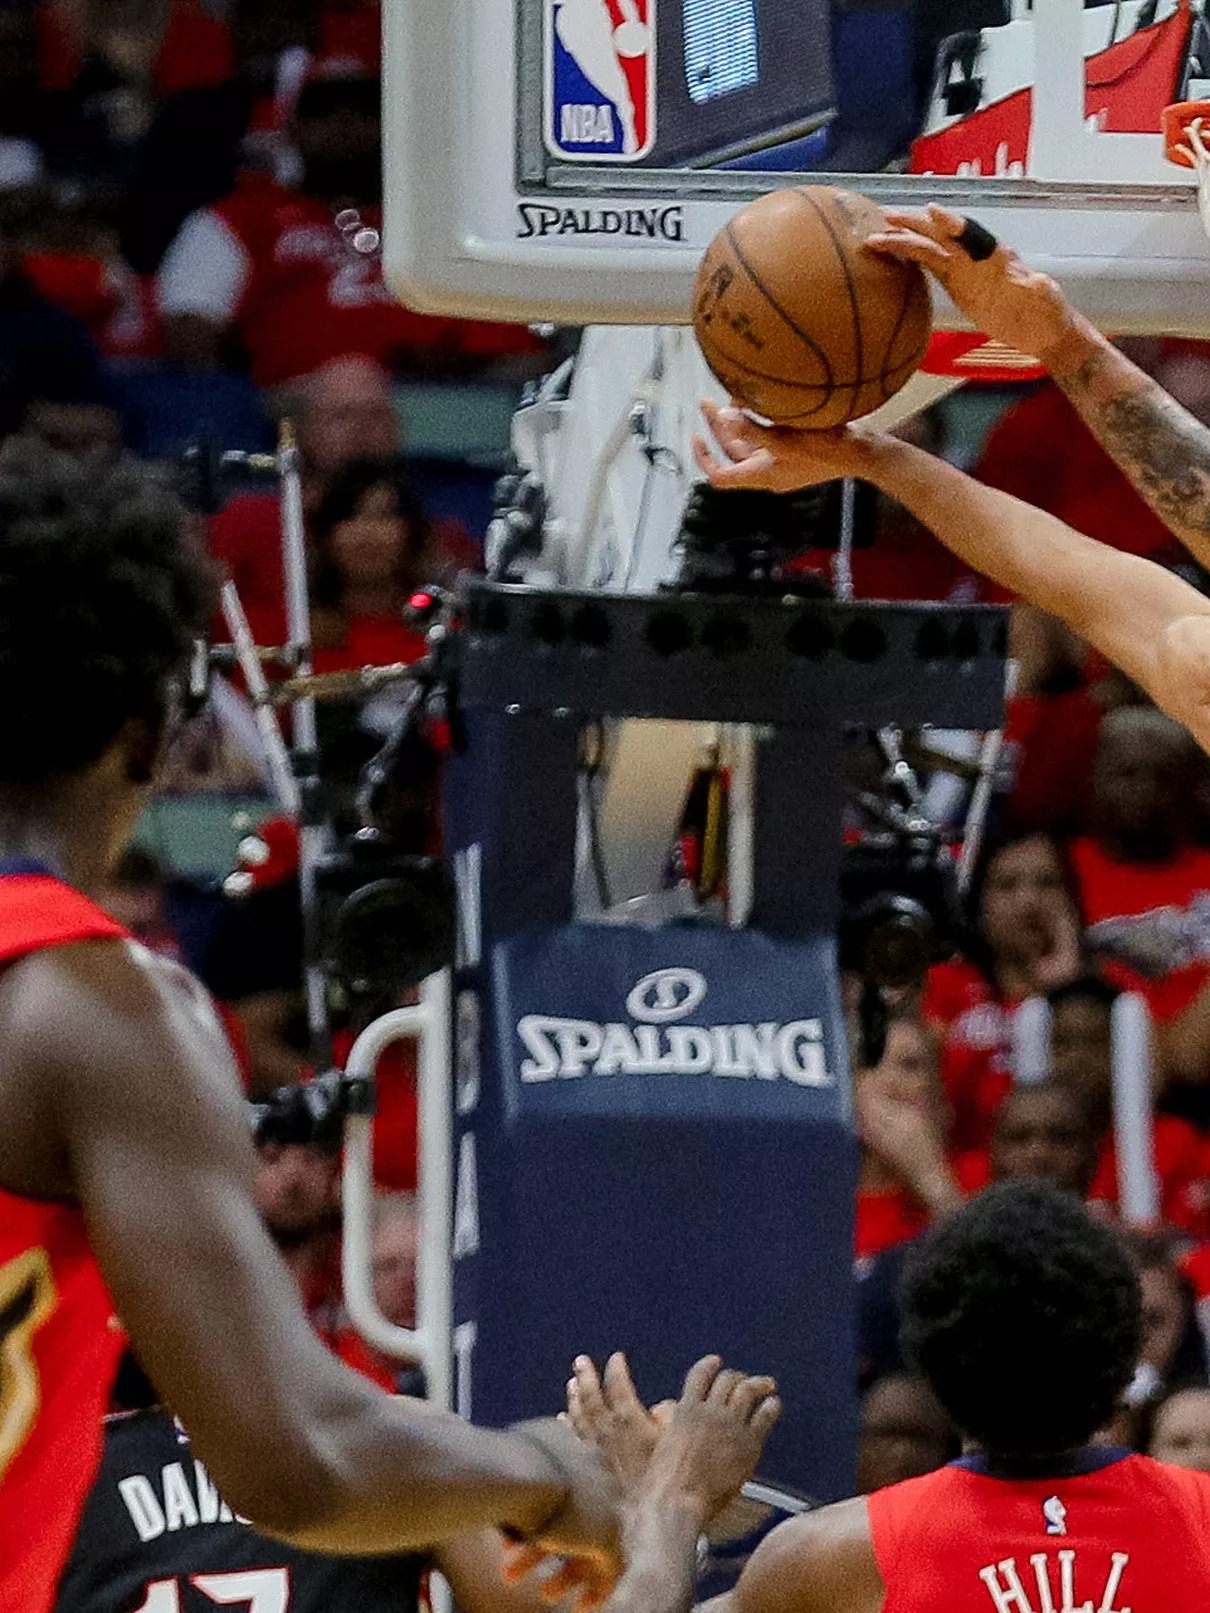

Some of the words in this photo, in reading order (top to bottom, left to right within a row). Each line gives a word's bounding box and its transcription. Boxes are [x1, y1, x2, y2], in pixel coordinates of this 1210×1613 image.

[561, 103, 615, 143] NBA
[517, 203, 687, 242] SPALDING
[516, 1013, 833, 1089] SPALDING
[978, 1549, 1132, 1613] HILL
